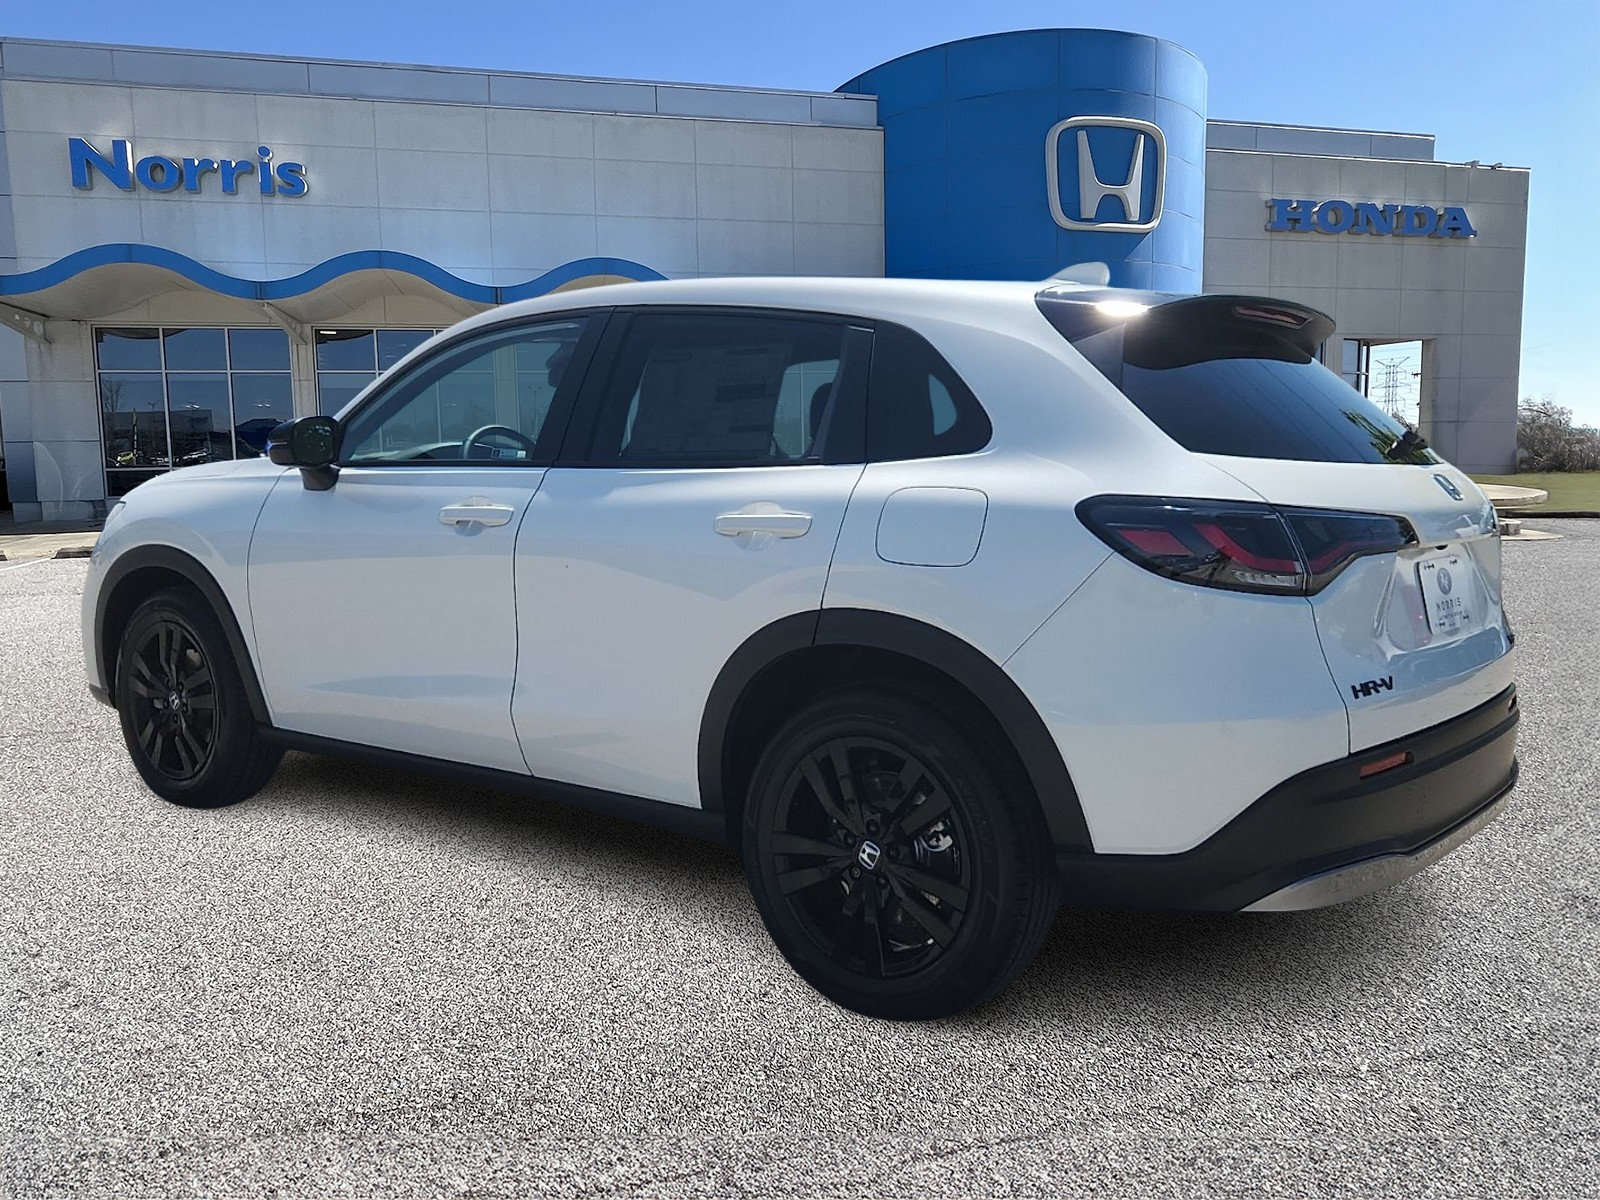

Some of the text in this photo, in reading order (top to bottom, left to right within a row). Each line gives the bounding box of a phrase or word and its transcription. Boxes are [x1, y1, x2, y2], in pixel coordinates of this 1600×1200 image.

[68, 137, 309, 197] Norris
[1265, 198, 1478, 239] HONDA
[1351, 676, 1393, 699] HR-V
